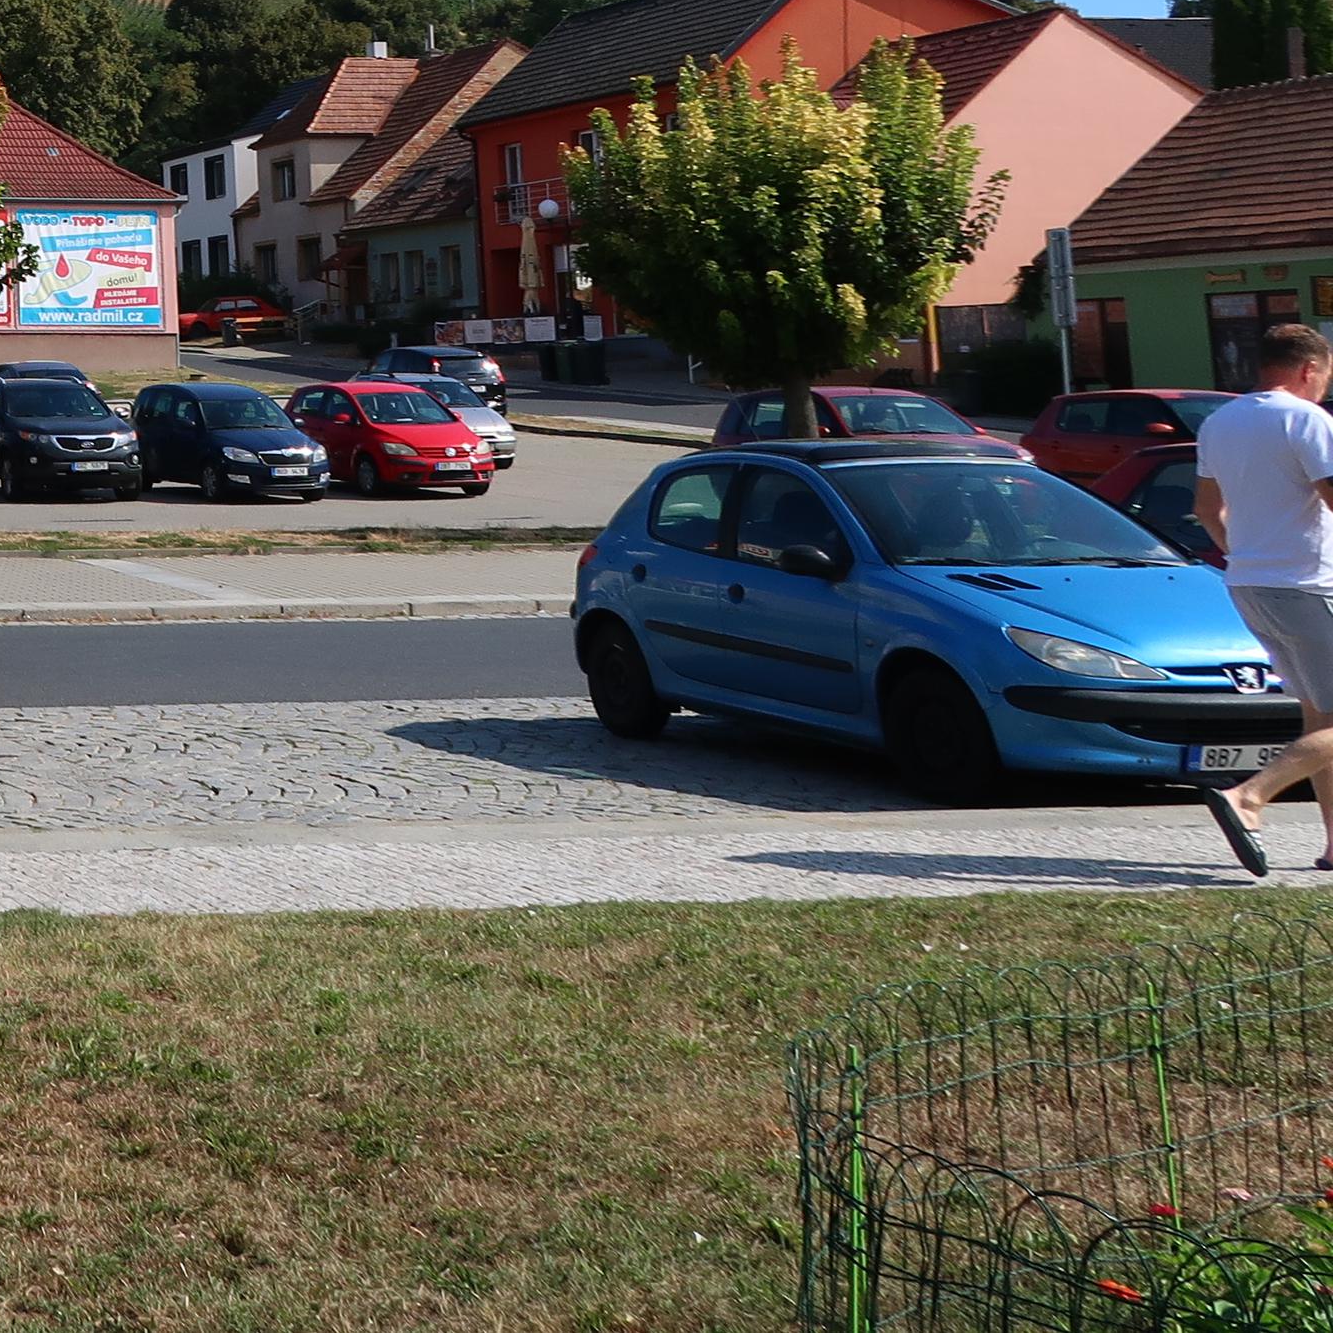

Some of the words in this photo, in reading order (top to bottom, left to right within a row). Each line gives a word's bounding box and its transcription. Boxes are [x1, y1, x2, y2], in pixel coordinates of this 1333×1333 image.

[72, 216, 105, 227] TOPO
[104, 233, 143, 247] pohodu
[95, 252, 110, 262] do
[111, 252, 148, 266] Vašeho
[38, 310, 144, 323] www.radmil.cz
[1205, 748, 1243, 768] 8B7
